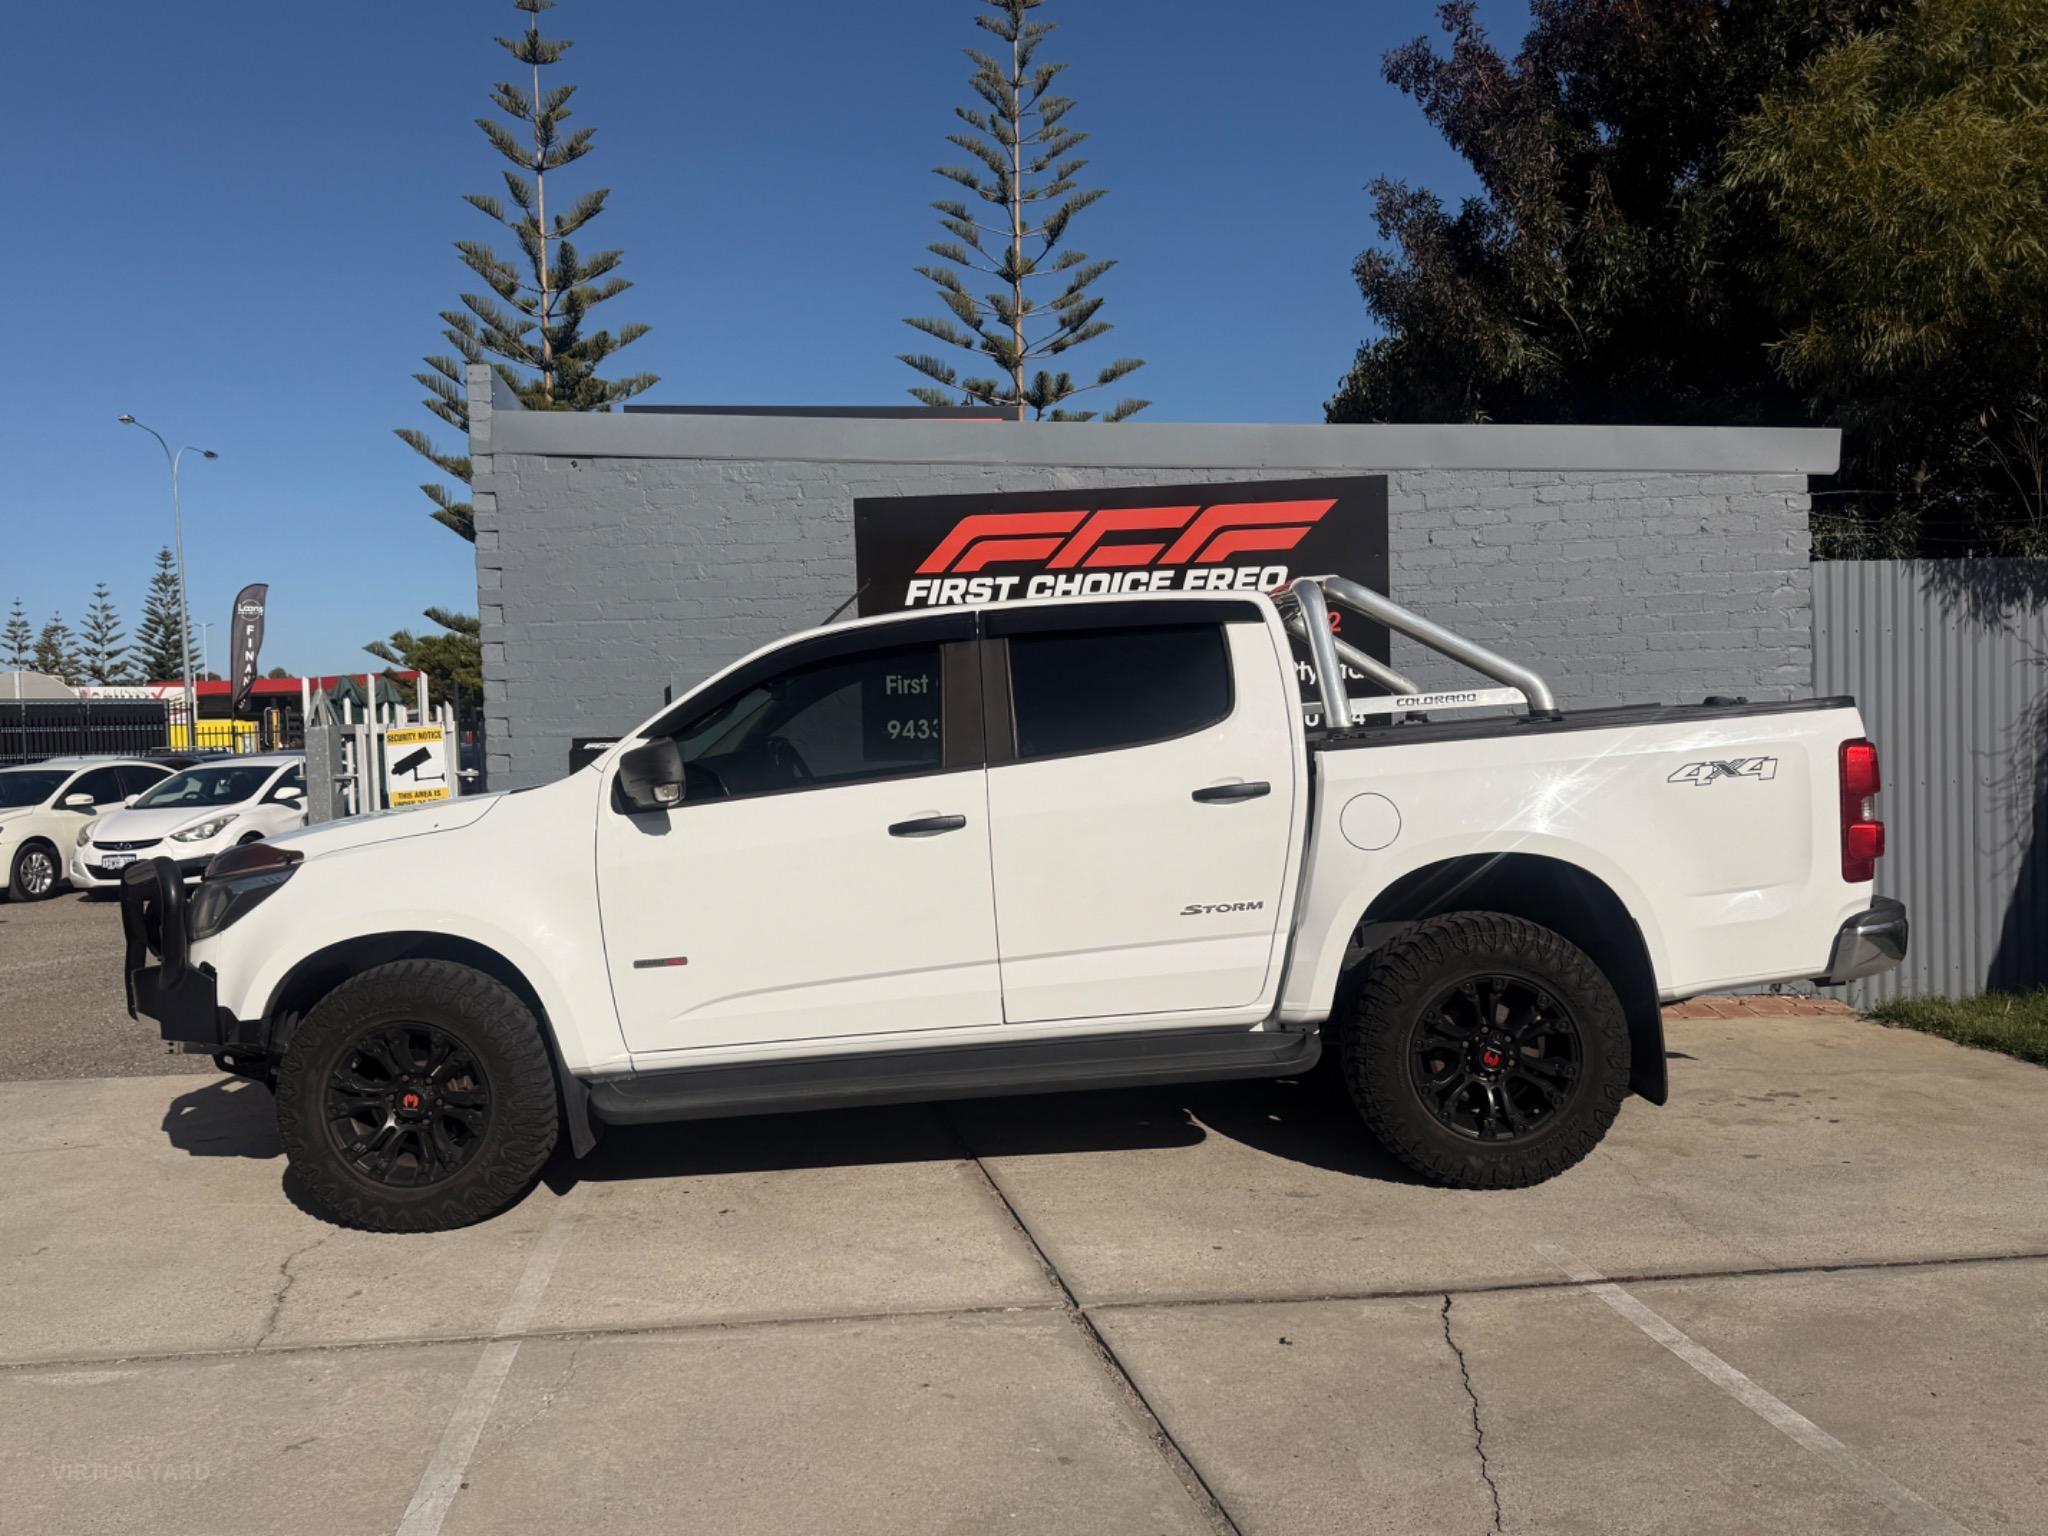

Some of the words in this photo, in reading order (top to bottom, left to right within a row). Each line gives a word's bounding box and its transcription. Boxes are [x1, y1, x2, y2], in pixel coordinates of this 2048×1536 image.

[904, 576, 1020, 606] FIRST
[1026, 570, 1176, 600] CHOICE
[1182, 565, 1288, 592] FREO
[885, 674, 929, 695] First
[1396, 693, 1477, 707] COLORADO
[387, 733, 417, 742] SECURITY
[418, 730, 442, 740] NOTICE
[415, 790, 432, 798] AREA
